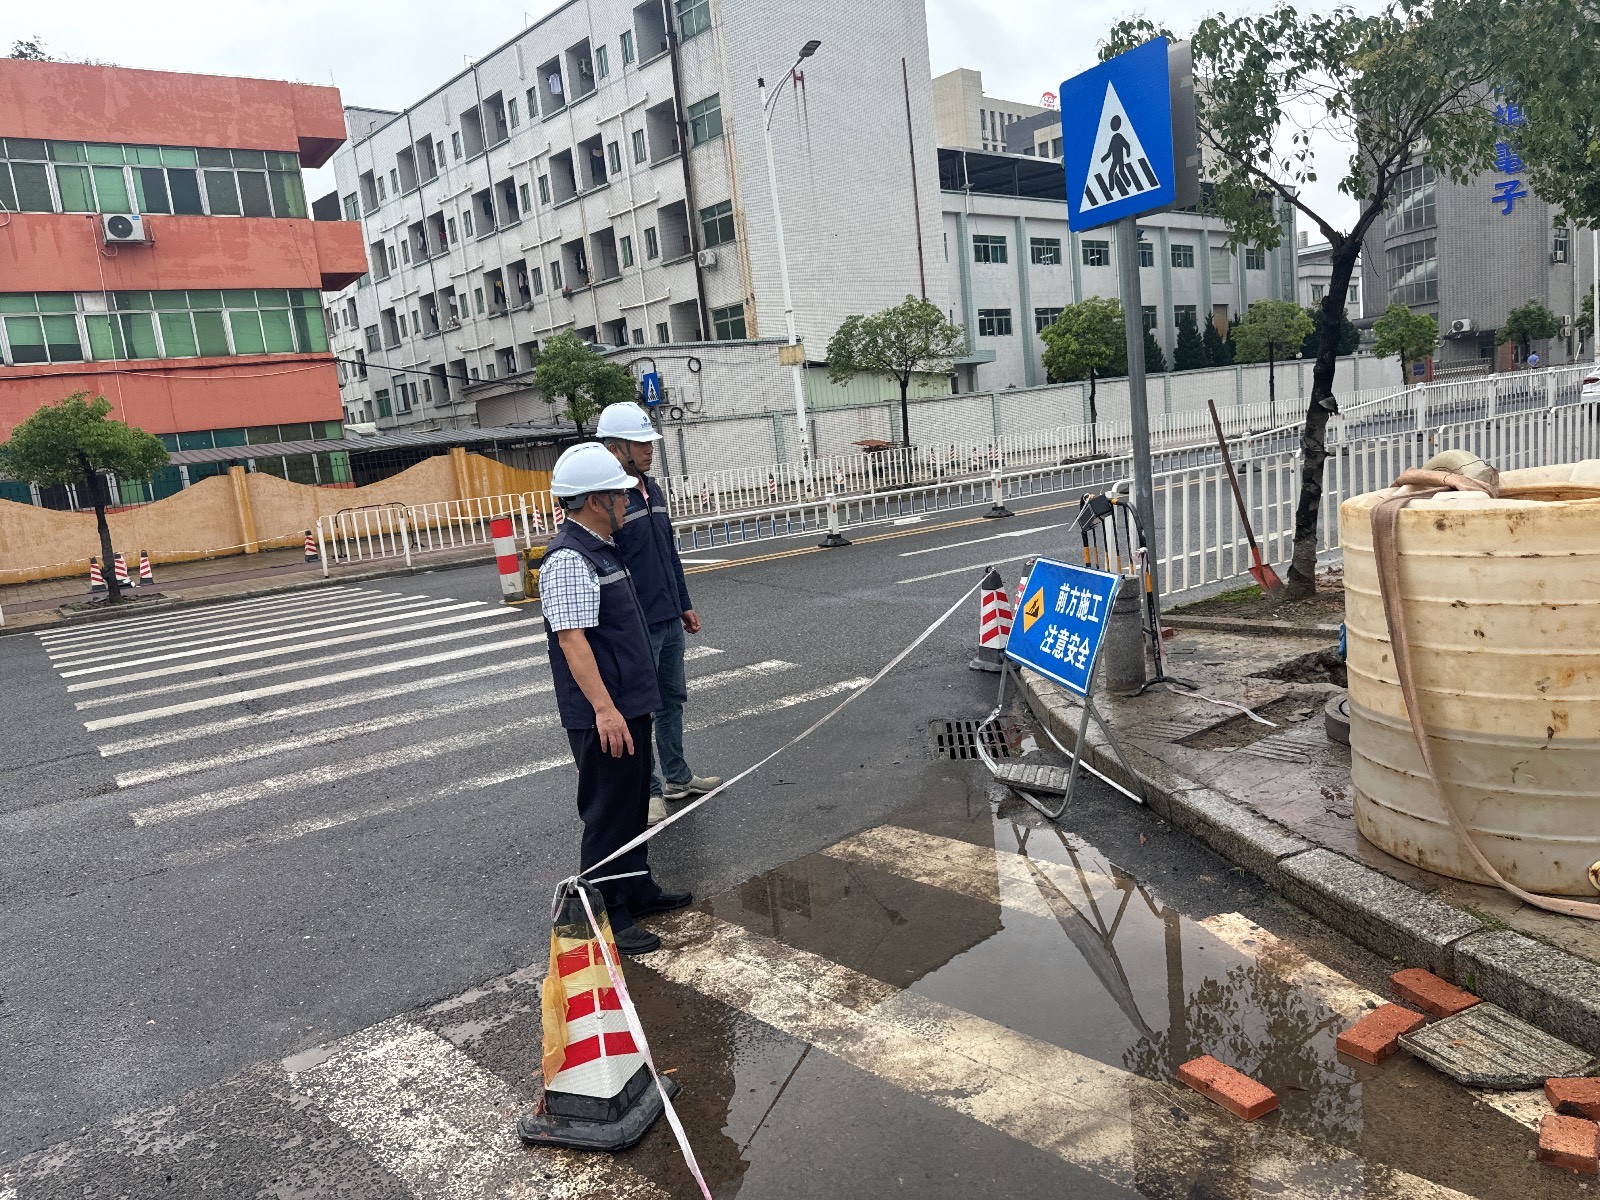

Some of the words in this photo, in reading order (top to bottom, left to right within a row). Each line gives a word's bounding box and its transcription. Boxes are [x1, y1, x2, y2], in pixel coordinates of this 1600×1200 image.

[1055, 583, 1102, 623] 前方施工
[1040, 624, 1090, 670] 注意安全
